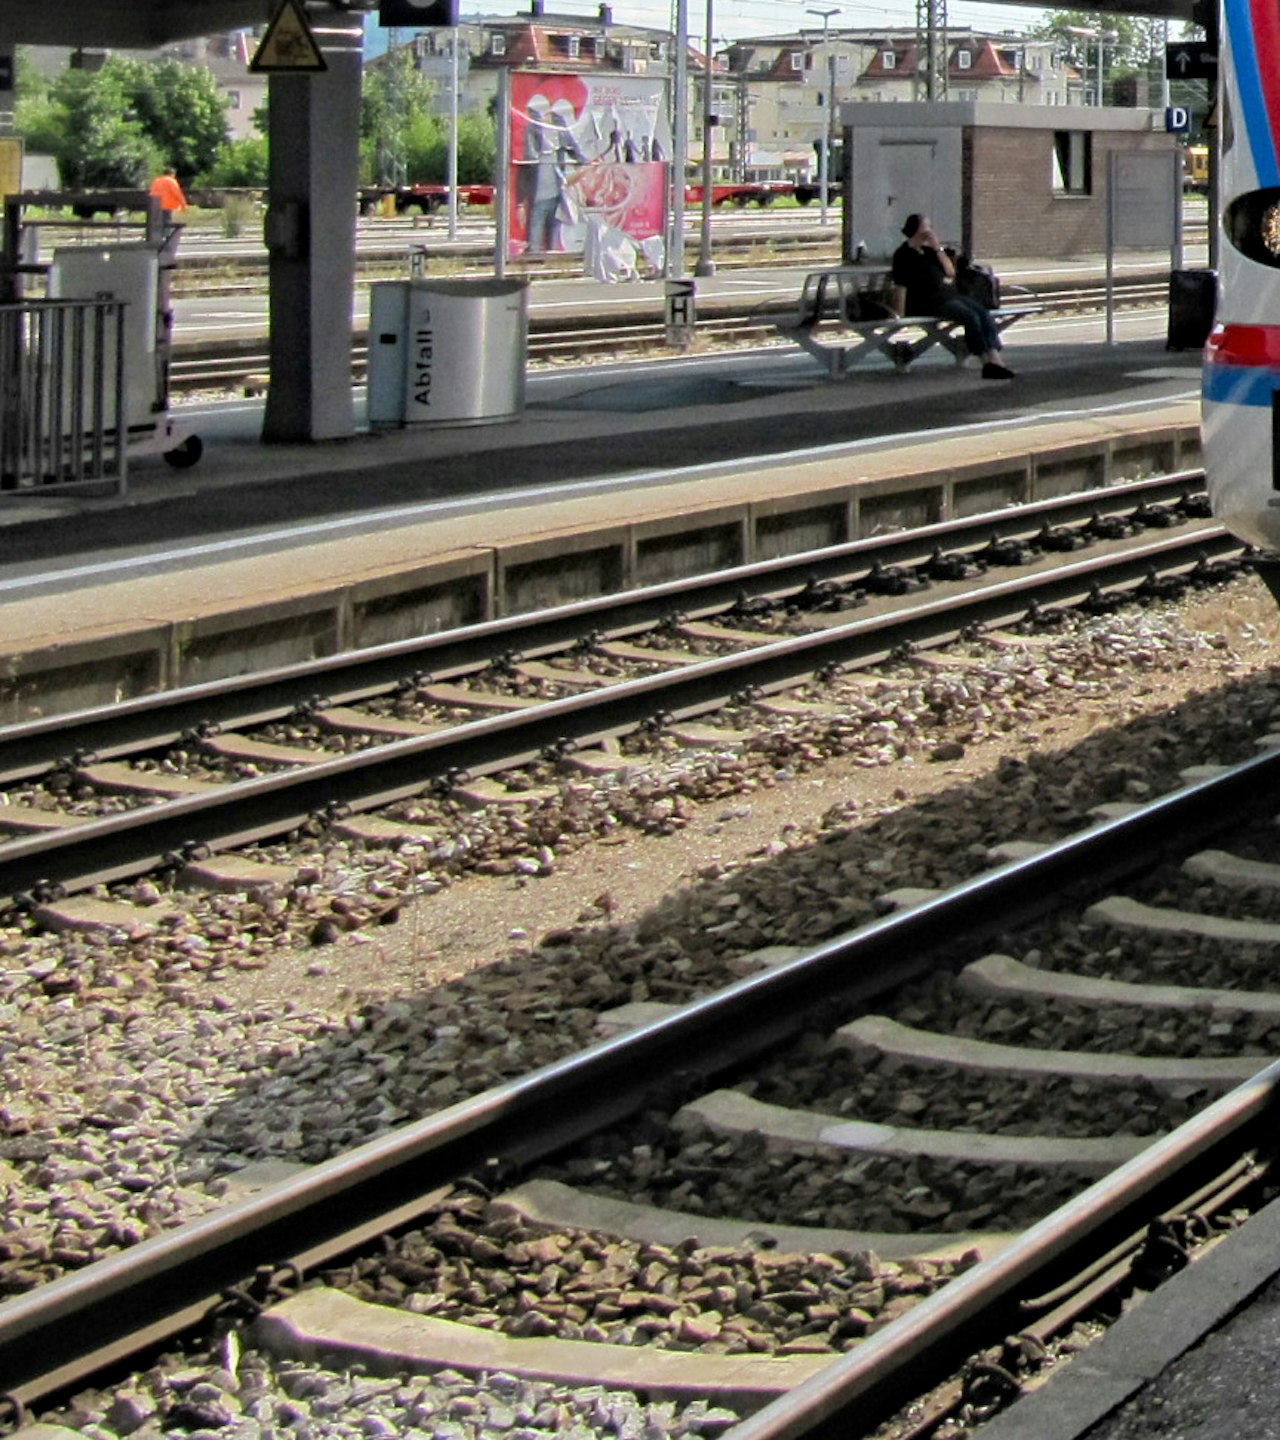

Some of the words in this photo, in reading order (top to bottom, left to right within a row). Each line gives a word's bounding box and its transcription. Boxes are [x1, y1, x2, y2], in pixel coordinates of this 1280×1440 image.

[1172, 107, 1188, 129] D
[671, 299, 687, 324] H
[413, 329, 433, 406] Abfall
